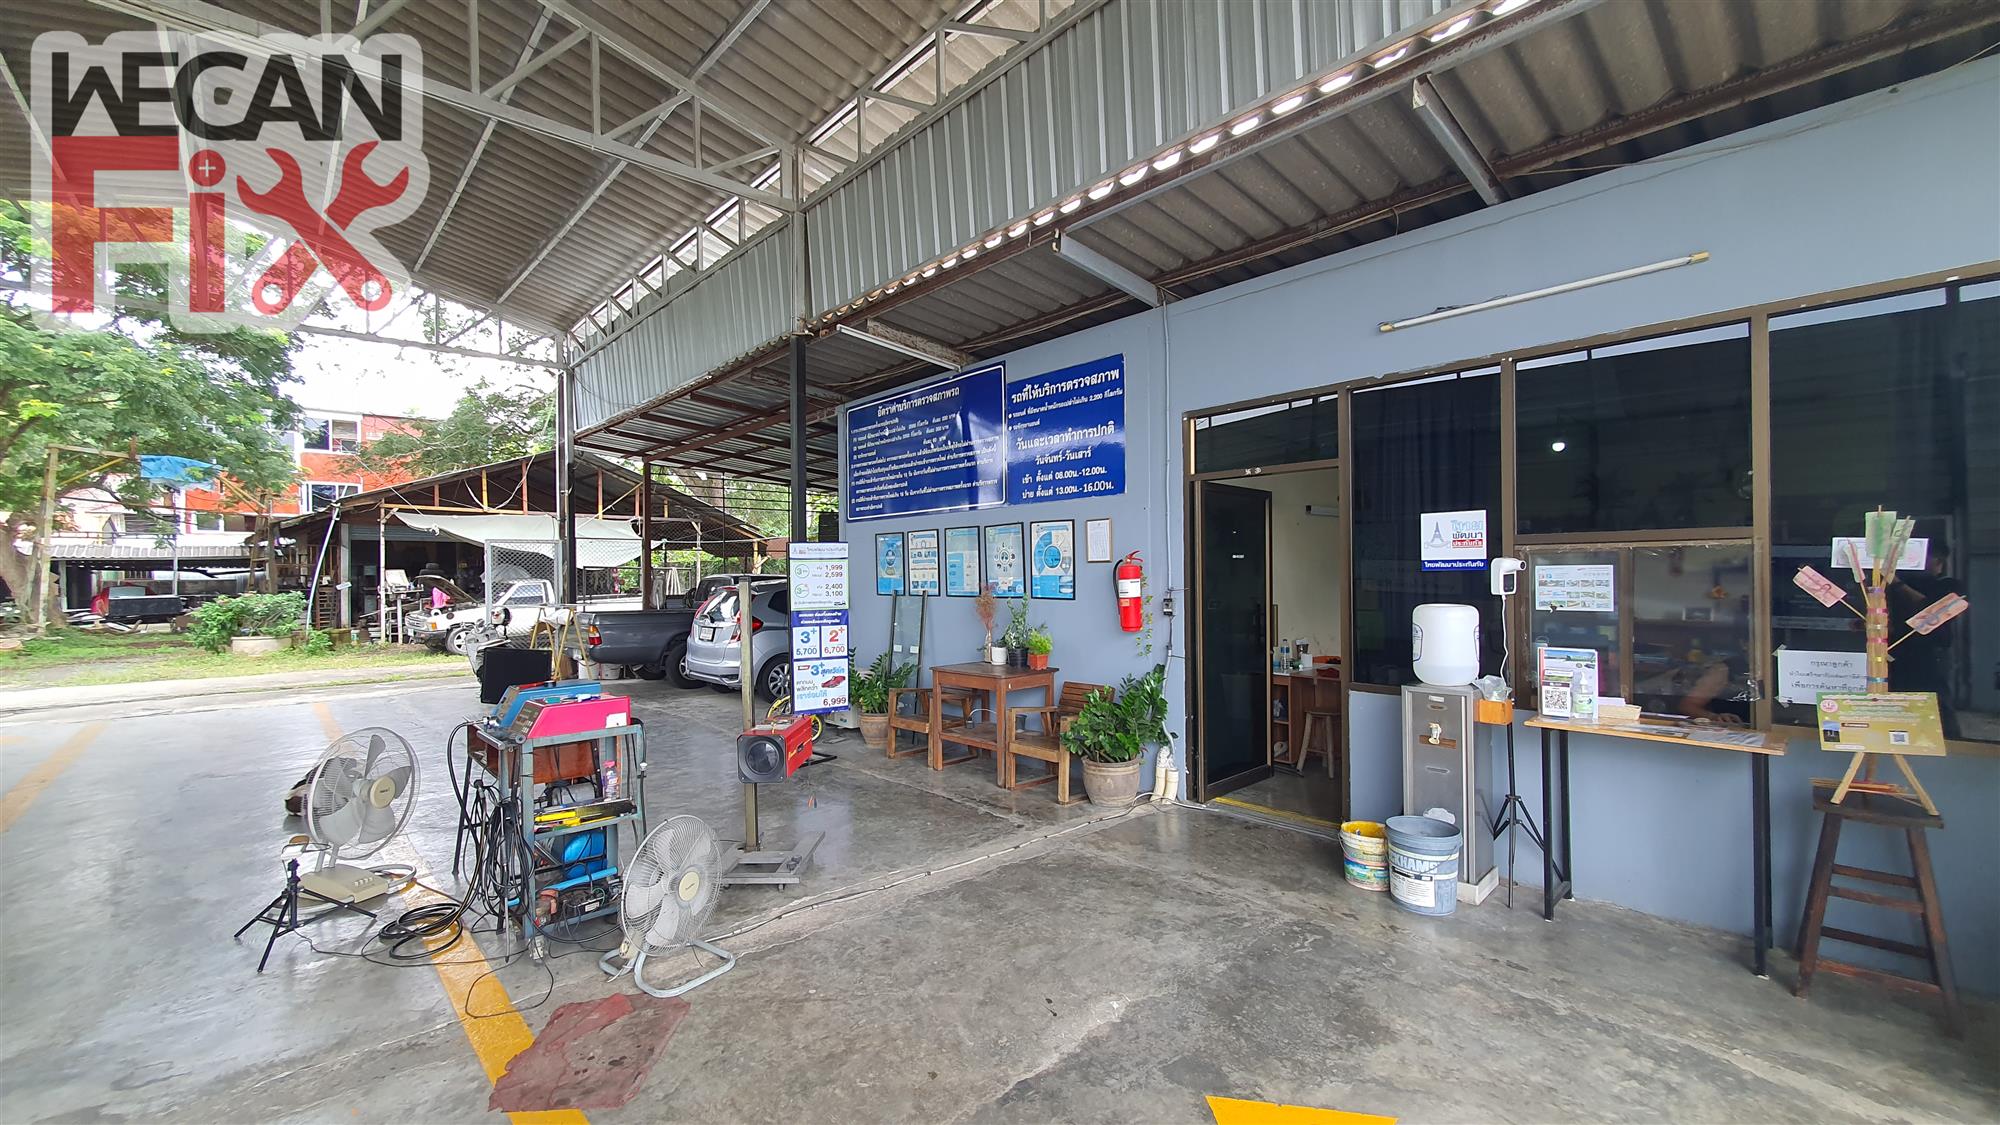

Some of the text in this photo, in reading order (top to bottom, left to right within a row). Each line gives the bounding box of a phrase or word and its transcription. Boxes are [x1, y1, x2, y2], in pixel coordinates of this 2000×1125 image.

[1011, 368, 1120, 404] รถที่ให้บริการตรวจสภาพ
[877, 386, 960, 418] อัตราค่าบริการตรวจสภาพรถ
[1016, 420, 1115, 450] วันและเวลาทำการปกติ
[1035, 445, 1093, 465] วันจันทร์-วันเสาร์
[1036, 470, 1053, 482] ตั้งแต่
[1036, 485, 1053, 497] ตั้งแต่
[796, 647, 817, 656] 5,700
[824, 645, 845, 654] 6,700
[823, 696, 847, 707] 6,999
